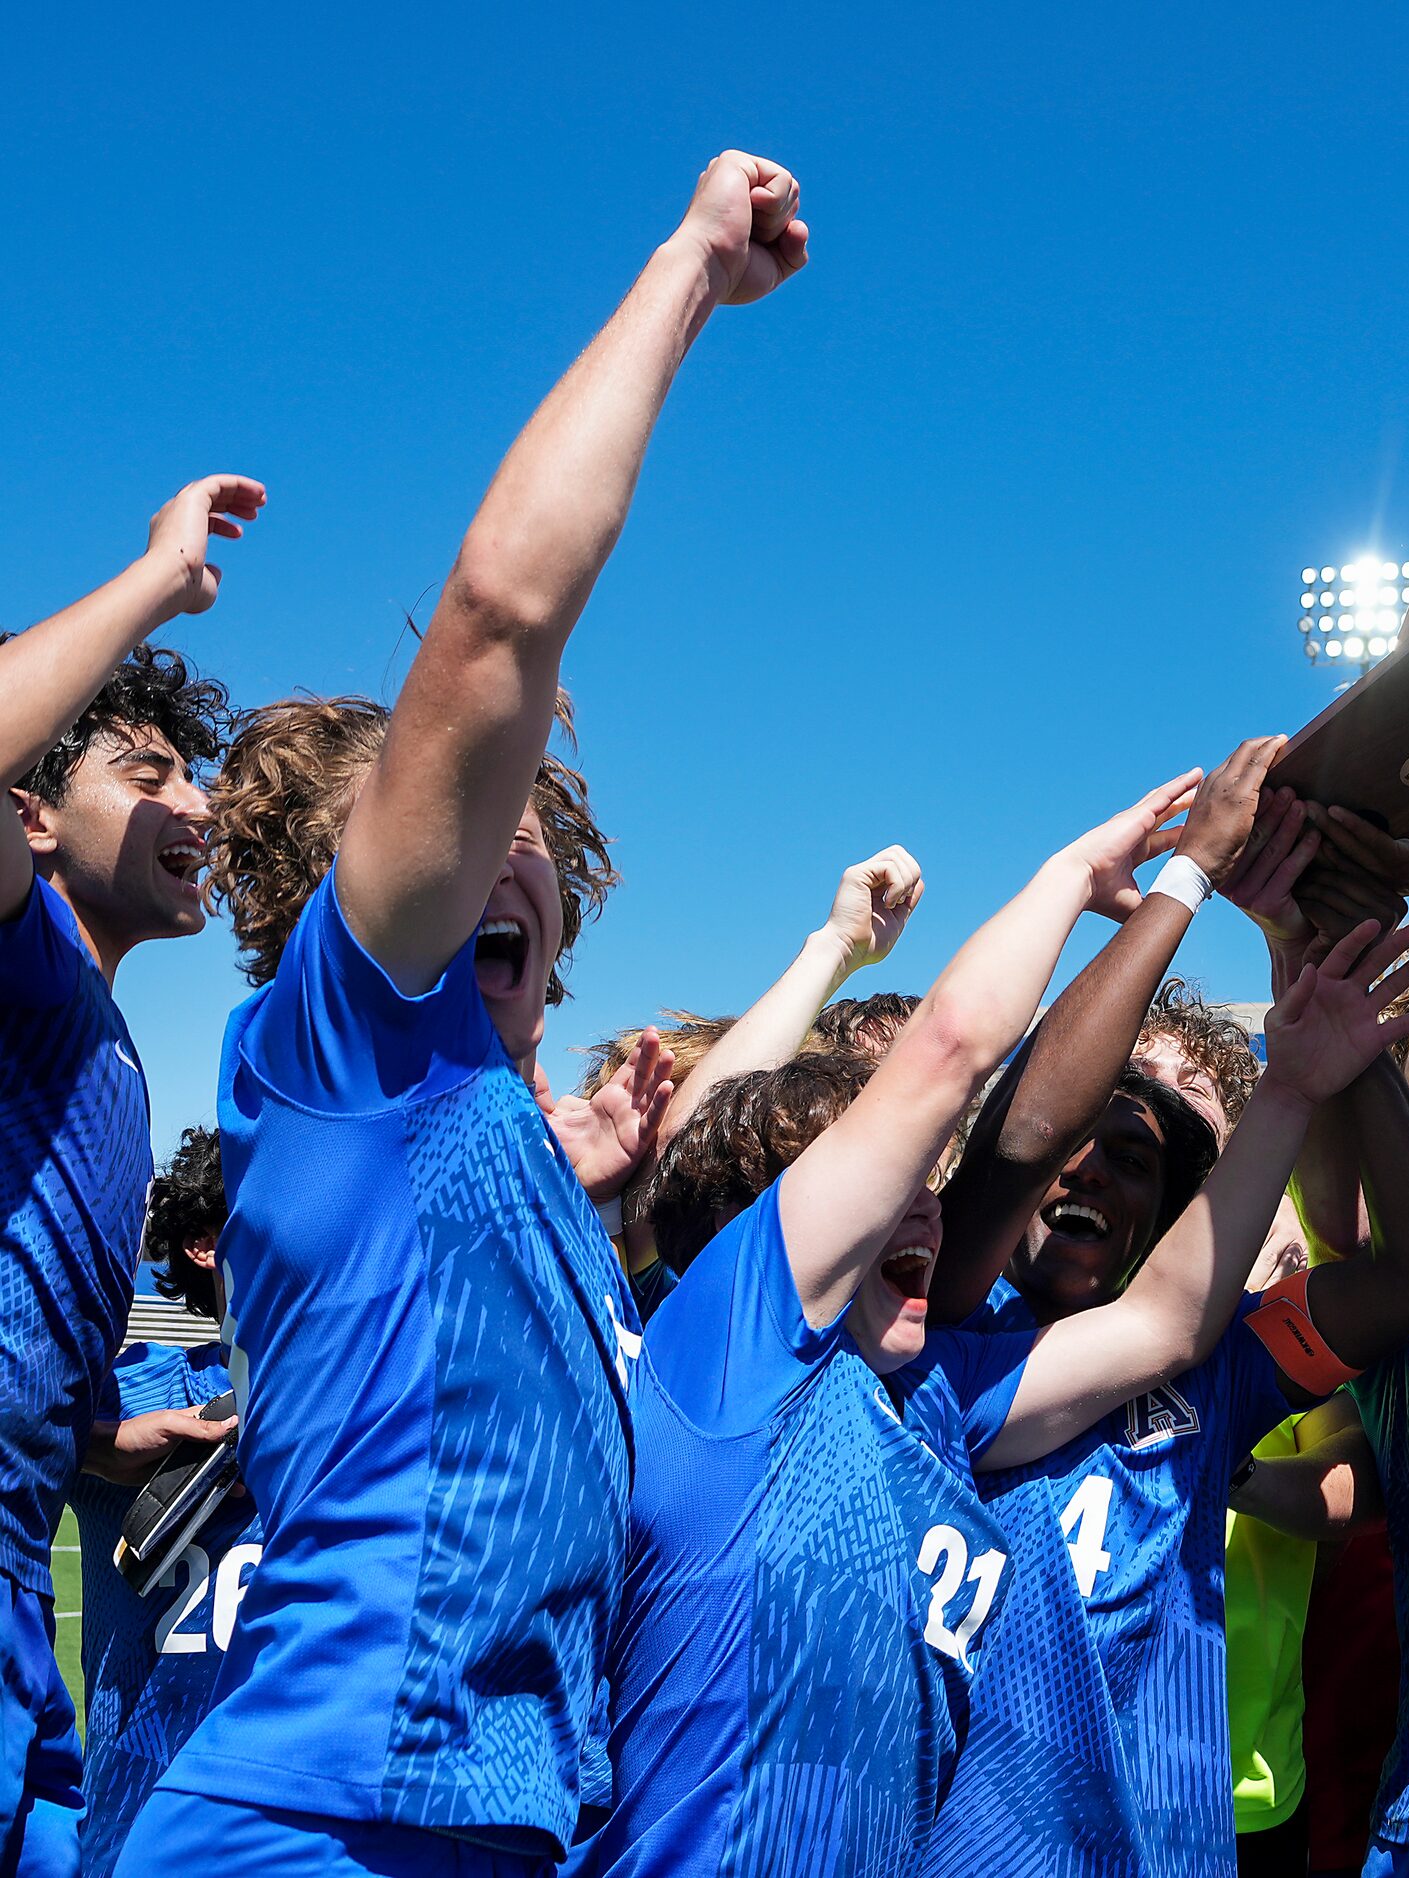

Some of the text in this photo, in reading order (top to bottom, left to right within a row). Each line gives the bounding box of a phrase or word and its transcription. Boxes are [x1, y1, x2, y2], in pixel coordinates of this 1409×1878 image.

[1124, 1381, 1201, 1451] A
[1059, 1475, 1113, 1598] 4
[917, 1524, 1007, 1674] 21
